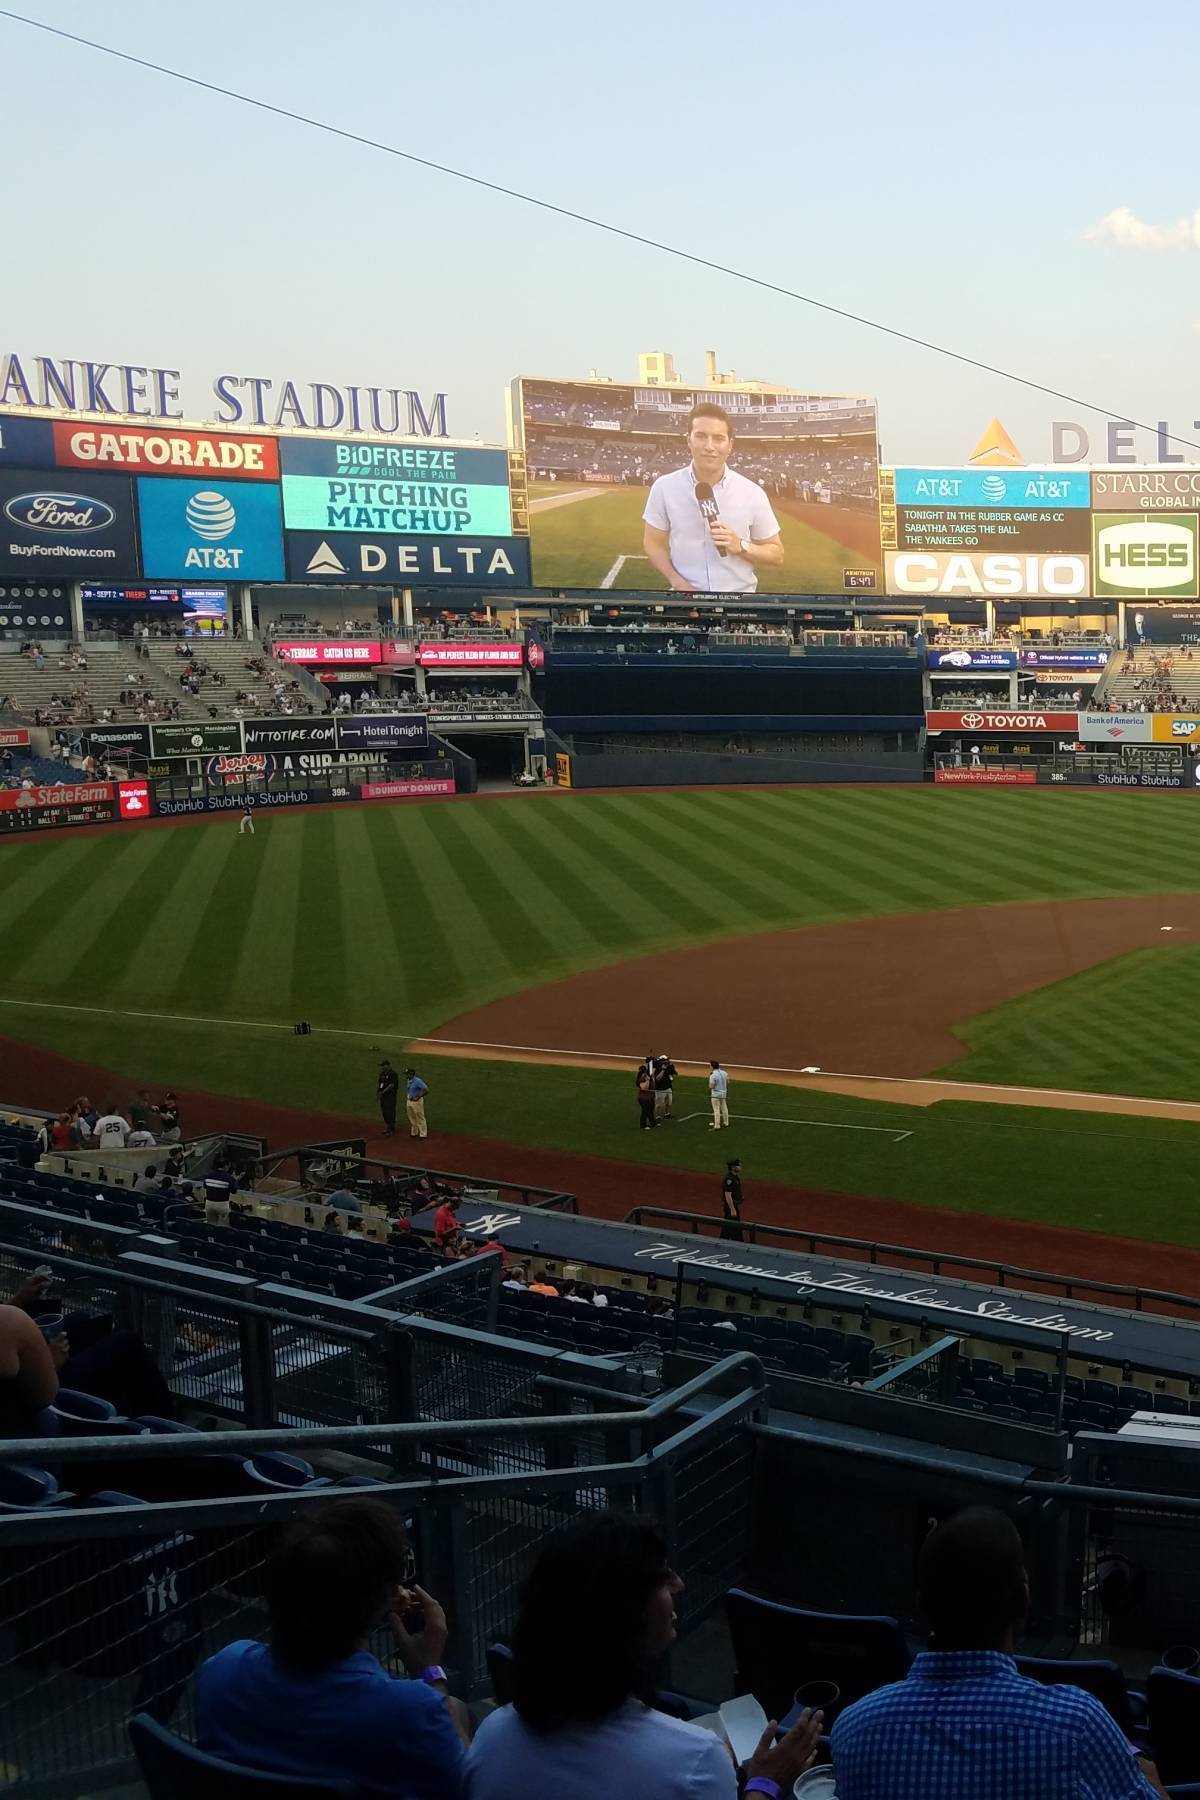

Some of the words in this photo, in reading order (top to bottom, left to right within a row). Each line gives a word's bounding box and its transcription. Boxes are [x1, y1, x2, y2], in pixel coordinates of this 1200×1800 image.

[214, 375, 451, 438] STADIUM
[71, 433, 264, 470] GATORADE
[374, 467, 401, 477] COOL
[407, 469, 427, 478] THE
[431, 470, 457, 480] PAIN
[916, 479, 962, 496] AT&T
[1025, 480, 1071, 497] AT&T
[1096, 474, 1169, 493] STARR
[328, 481, 468, 508] PITCHING
[1140, 496, 1189, 507] GLOBAL
[27, 499, 93, 528] Ford
[327, 505, 472, 531] MATCHUP
[904, 511, 944, 520] TONIGHT
[947, 511, 957, 520] IN
[958, 512, 976, 520] THE
[978, 512, 1011, 521] RUBBER
[1014, 513, 1038, 521] GAME
[1040, 513, 1051, 521] AS
[1053, 513, 1064, 521] CC
[905, 524, 948, 533] SABATHIA
[949, 524, 976, 533] TAKES
[978, 525, 996, 534] THE
[905, 536, 922, 544] THE
[925, 536, 963, 545] YANKEES
[965, 537, 978, 545] GO
[9, 544, 115, 560] BuyFordNow.com
[184, 548, 244, 569] AT&T
[360, 545, 515, 575] DELTA
[1104, 544, 1188, 567] HESS
[894, 554, 1085, 594] CASIO
[125, 591, 147, 599] TIGERS
[290, 648, 318, 659] TERRACE
[323, 648, 343, 658] CATCH
[344, 648, 353, 658] US
[353, 648, 370, 658] HERE
[986, 716, 1047, 728] TOYOTA
[1087, 717, 1105, 725] Bank
[1115, 717, 1144, 725] America
[1172, 723, 1196, 735] SAP
[90, 732, 143, 742] Panasonic
[246, 726, 335, 744] NITTOTIRE.COM
[1059, 742, 1087, 752] FedEx
[216, 754, 265, 772] Jersey
[284, 755, 295, 777] A
[375, 785, 410, 795] DUNKIN'
[410, 783, 448, 793] DONUTS
[1098, 775, 1137, 785] StubHub
[1141, 775, 1180, 786] StubHub
[332, 788, 346, 797] 399
[159, 799, 204, 814] StubHub
[208, 794, 255, 809] StubHub
[259, 791, 308, 805] StubHub
[634, 1243, 780, 1278] Welcome
